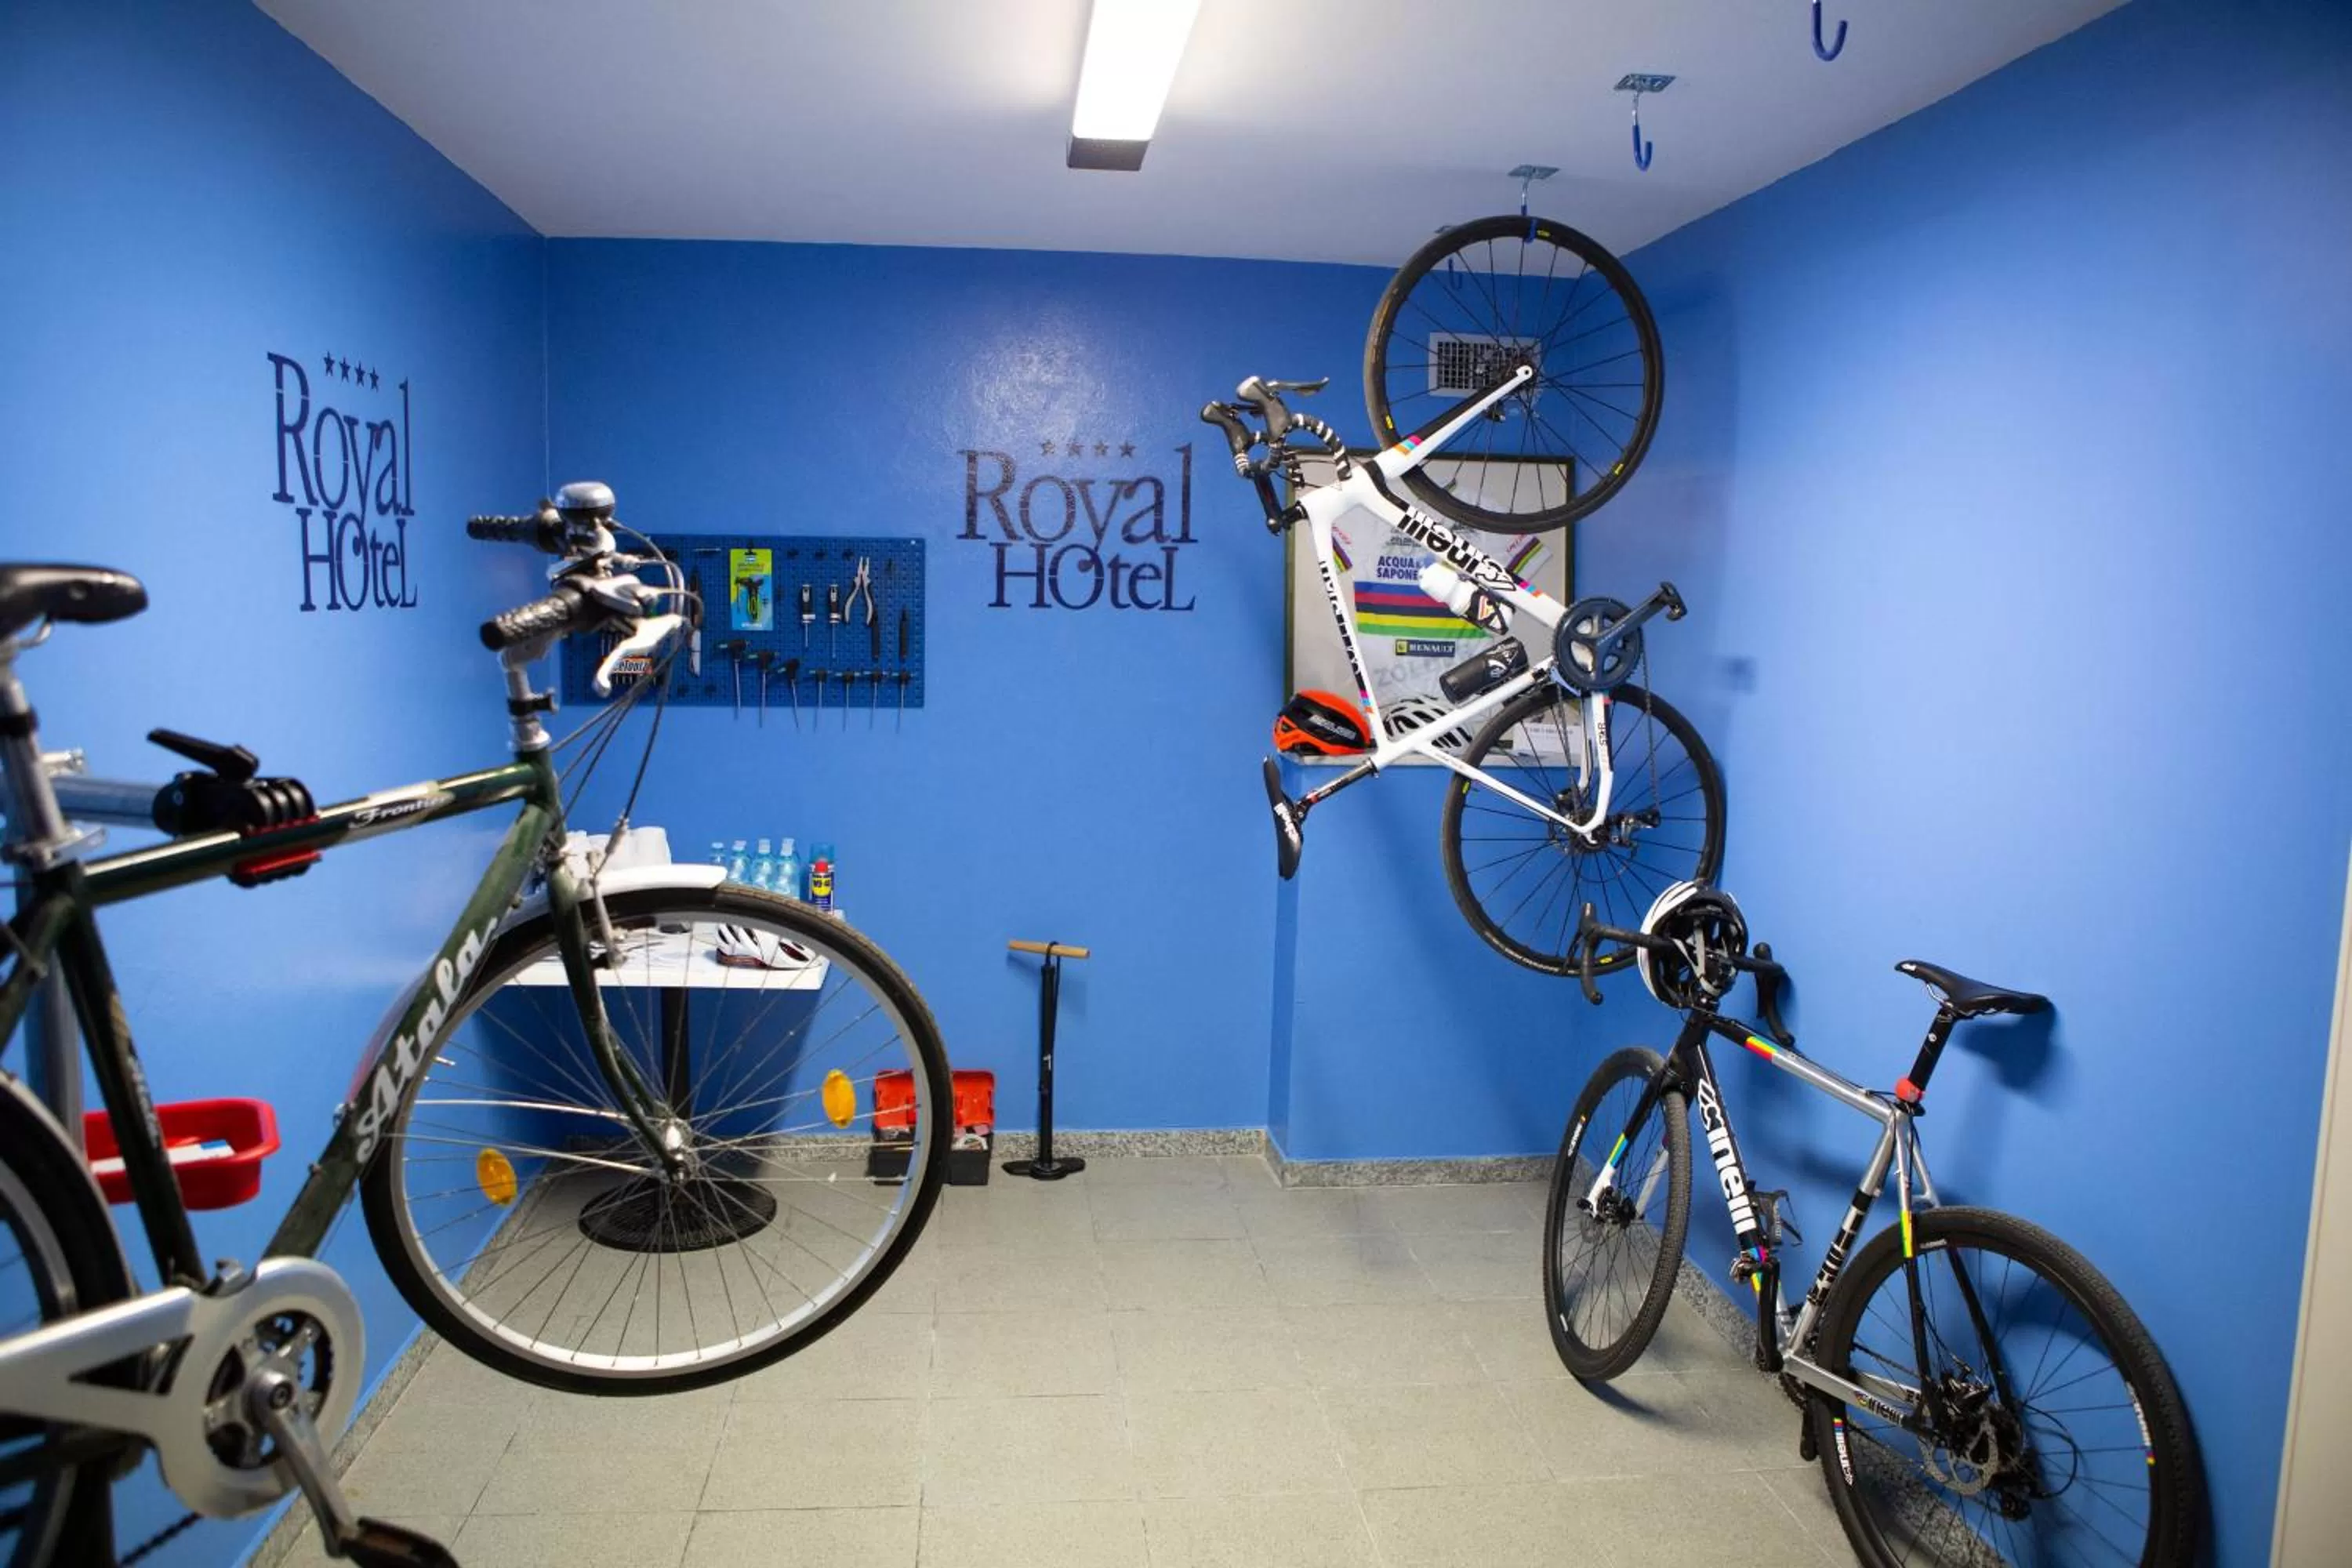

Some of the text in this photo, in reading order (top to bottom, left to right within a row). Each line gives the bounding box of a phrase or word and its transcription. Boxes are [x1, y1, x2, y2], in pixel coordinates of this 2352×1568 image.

[267, 350, 415, 555] Royal
[956, 441, 1199, 572] Royal
[1377, 555, 1415, 568] ACQUA
[1377, 567, 1418, 580] SAPONE
[1409, 643, 1455, 654] RENAULT
[355, 916, 499, 1164] Atala
